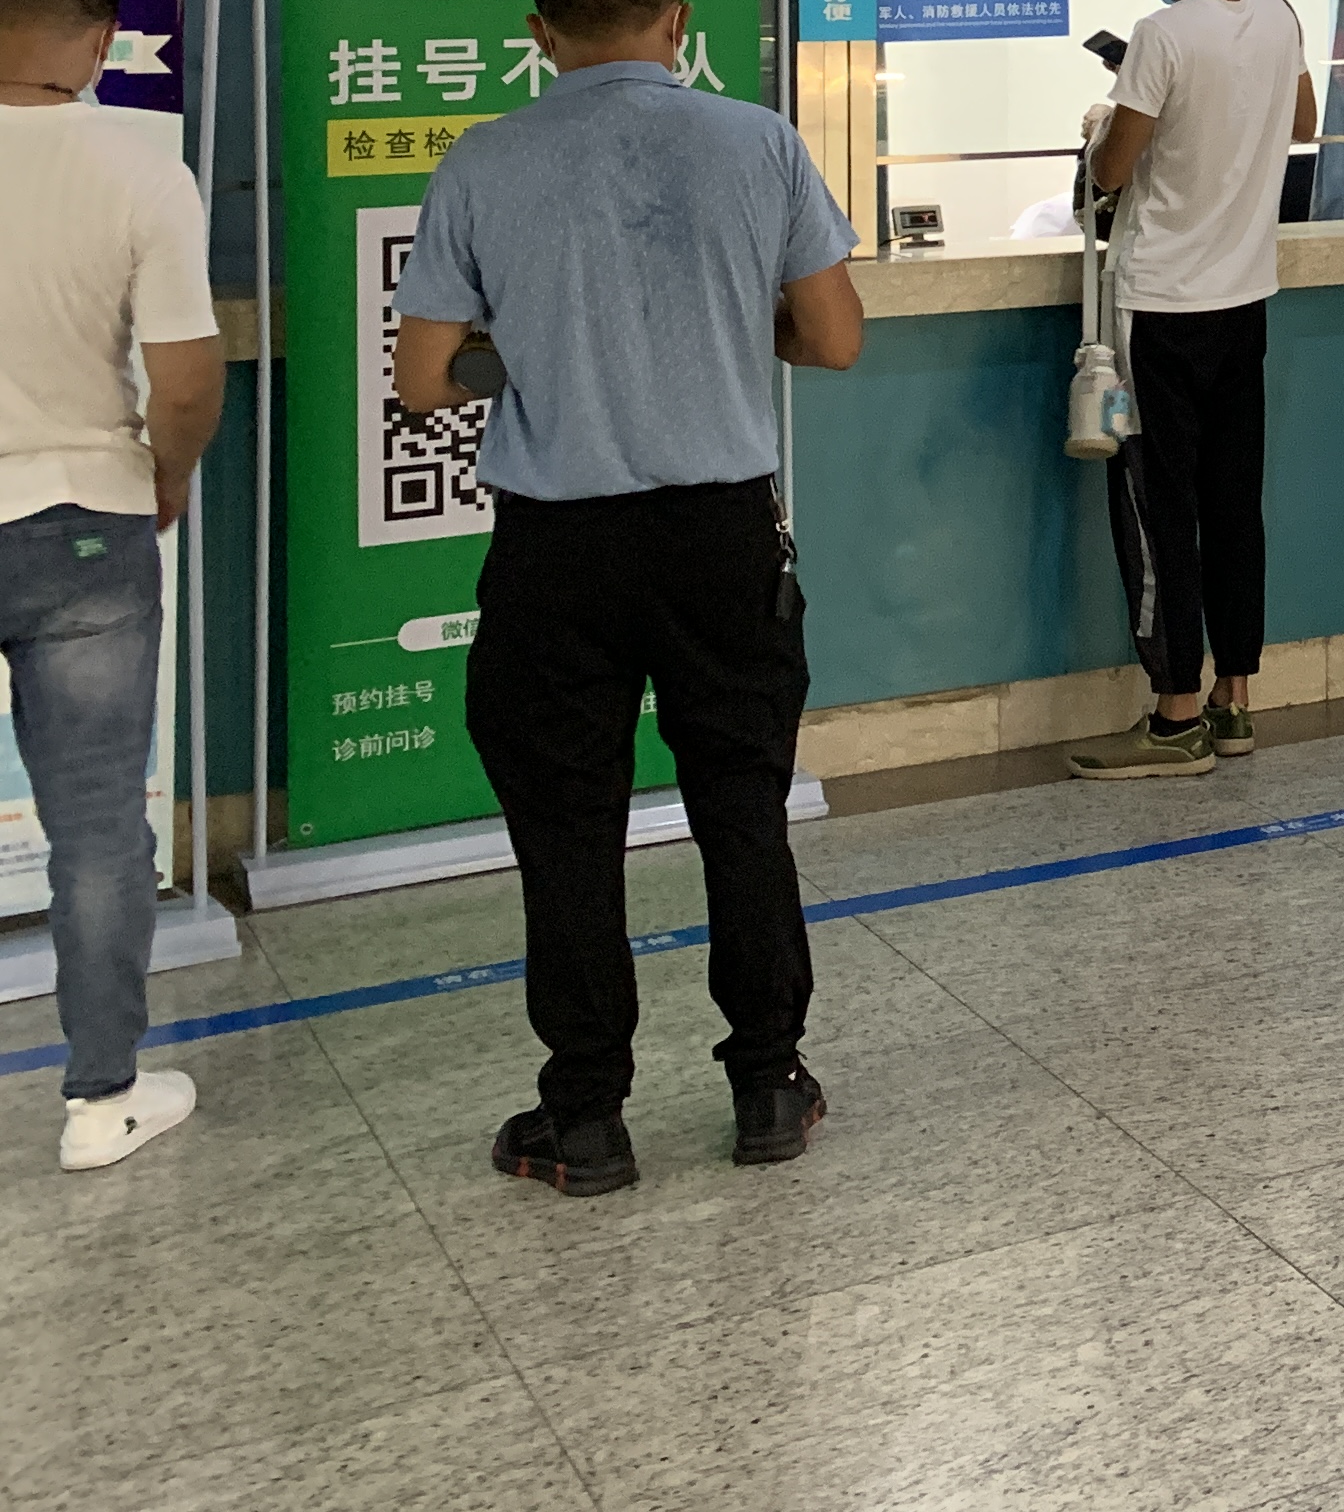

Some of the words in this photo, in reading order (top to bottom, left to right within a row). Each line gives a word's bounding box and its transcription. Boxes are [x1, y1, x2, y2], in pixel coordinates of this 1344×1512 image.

[332, 680, 434, 716] 预约挂号
[332, 726, 436, 762] 诊前问诊
